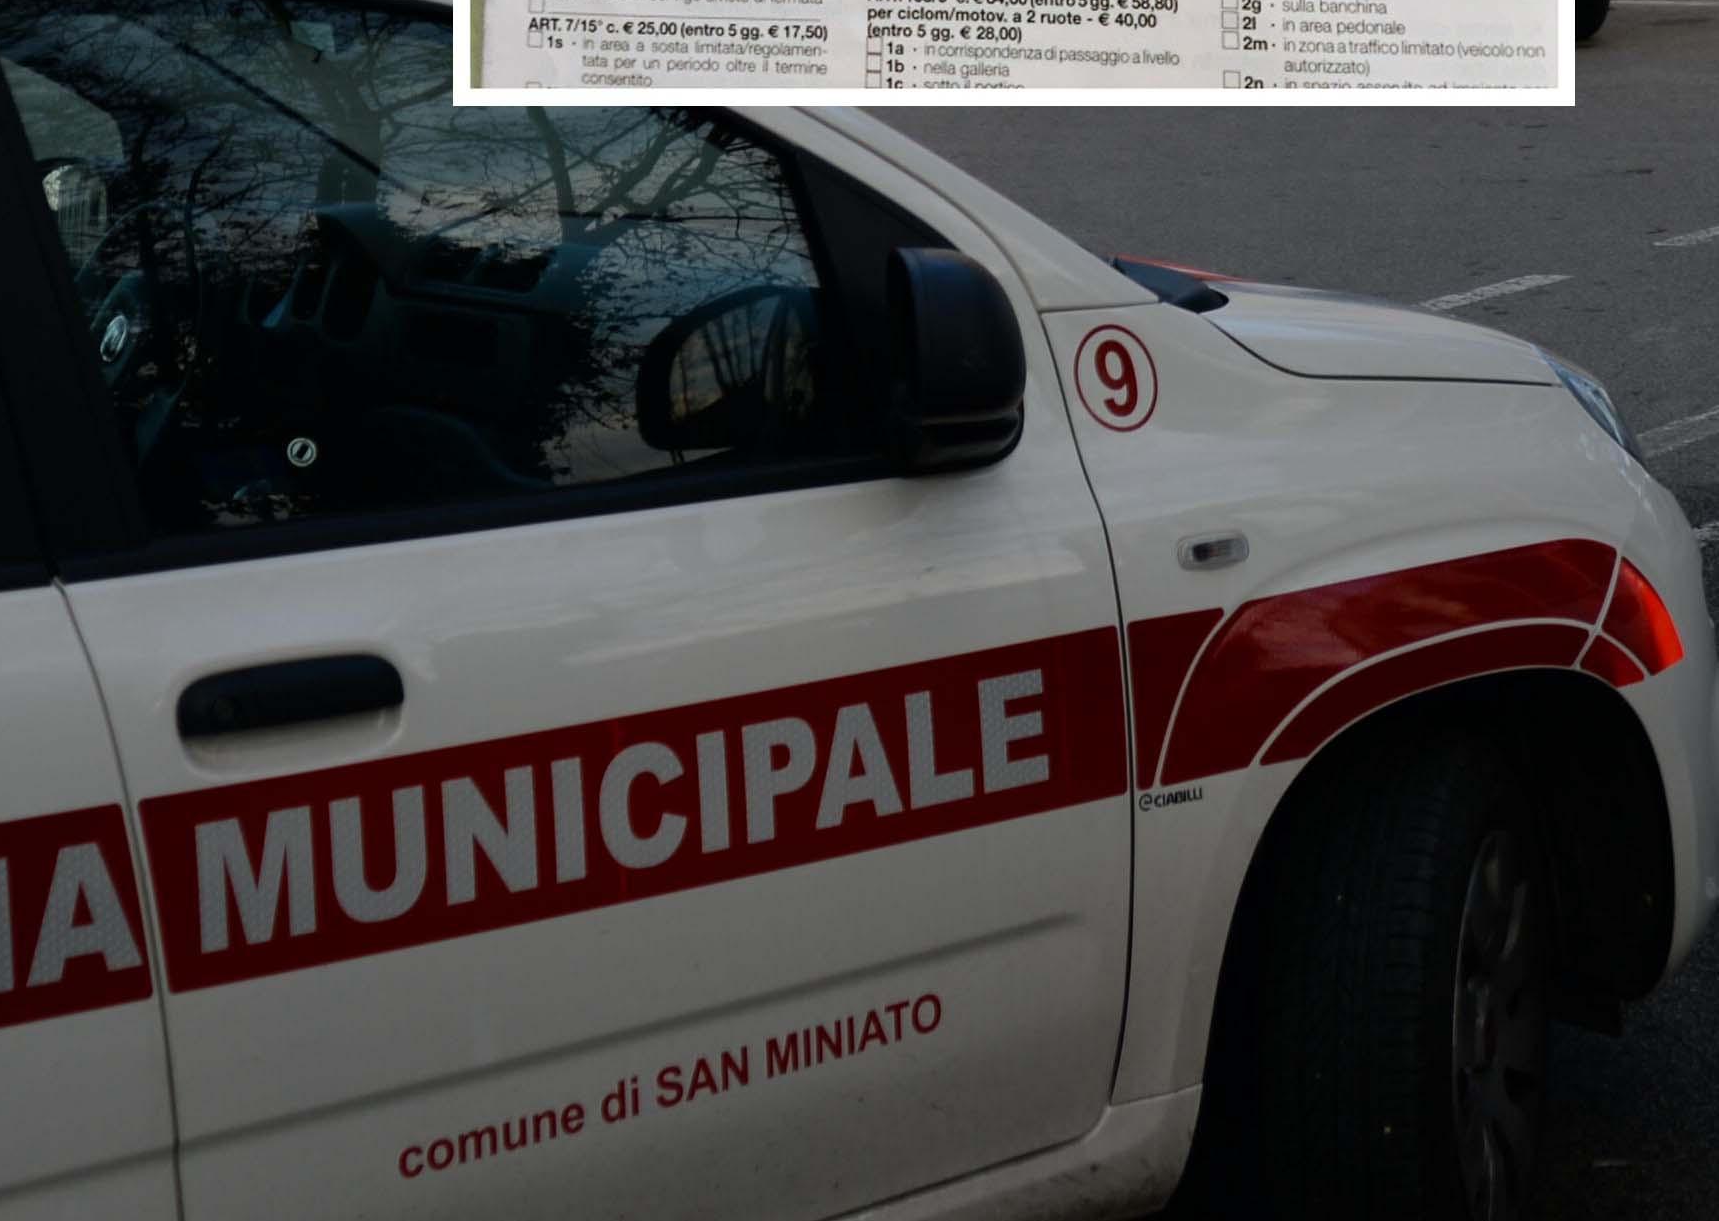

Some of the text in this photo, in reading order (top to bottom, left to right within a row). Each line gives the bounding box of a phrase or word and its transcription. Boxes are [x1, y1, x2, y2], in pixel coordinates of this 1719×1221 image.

[1092, 338, 1140, 418] 9
[195, 669, 1051, 953] MUNICIPALE
[397, 994, 944, 1181] comune di SAN MINIATO
